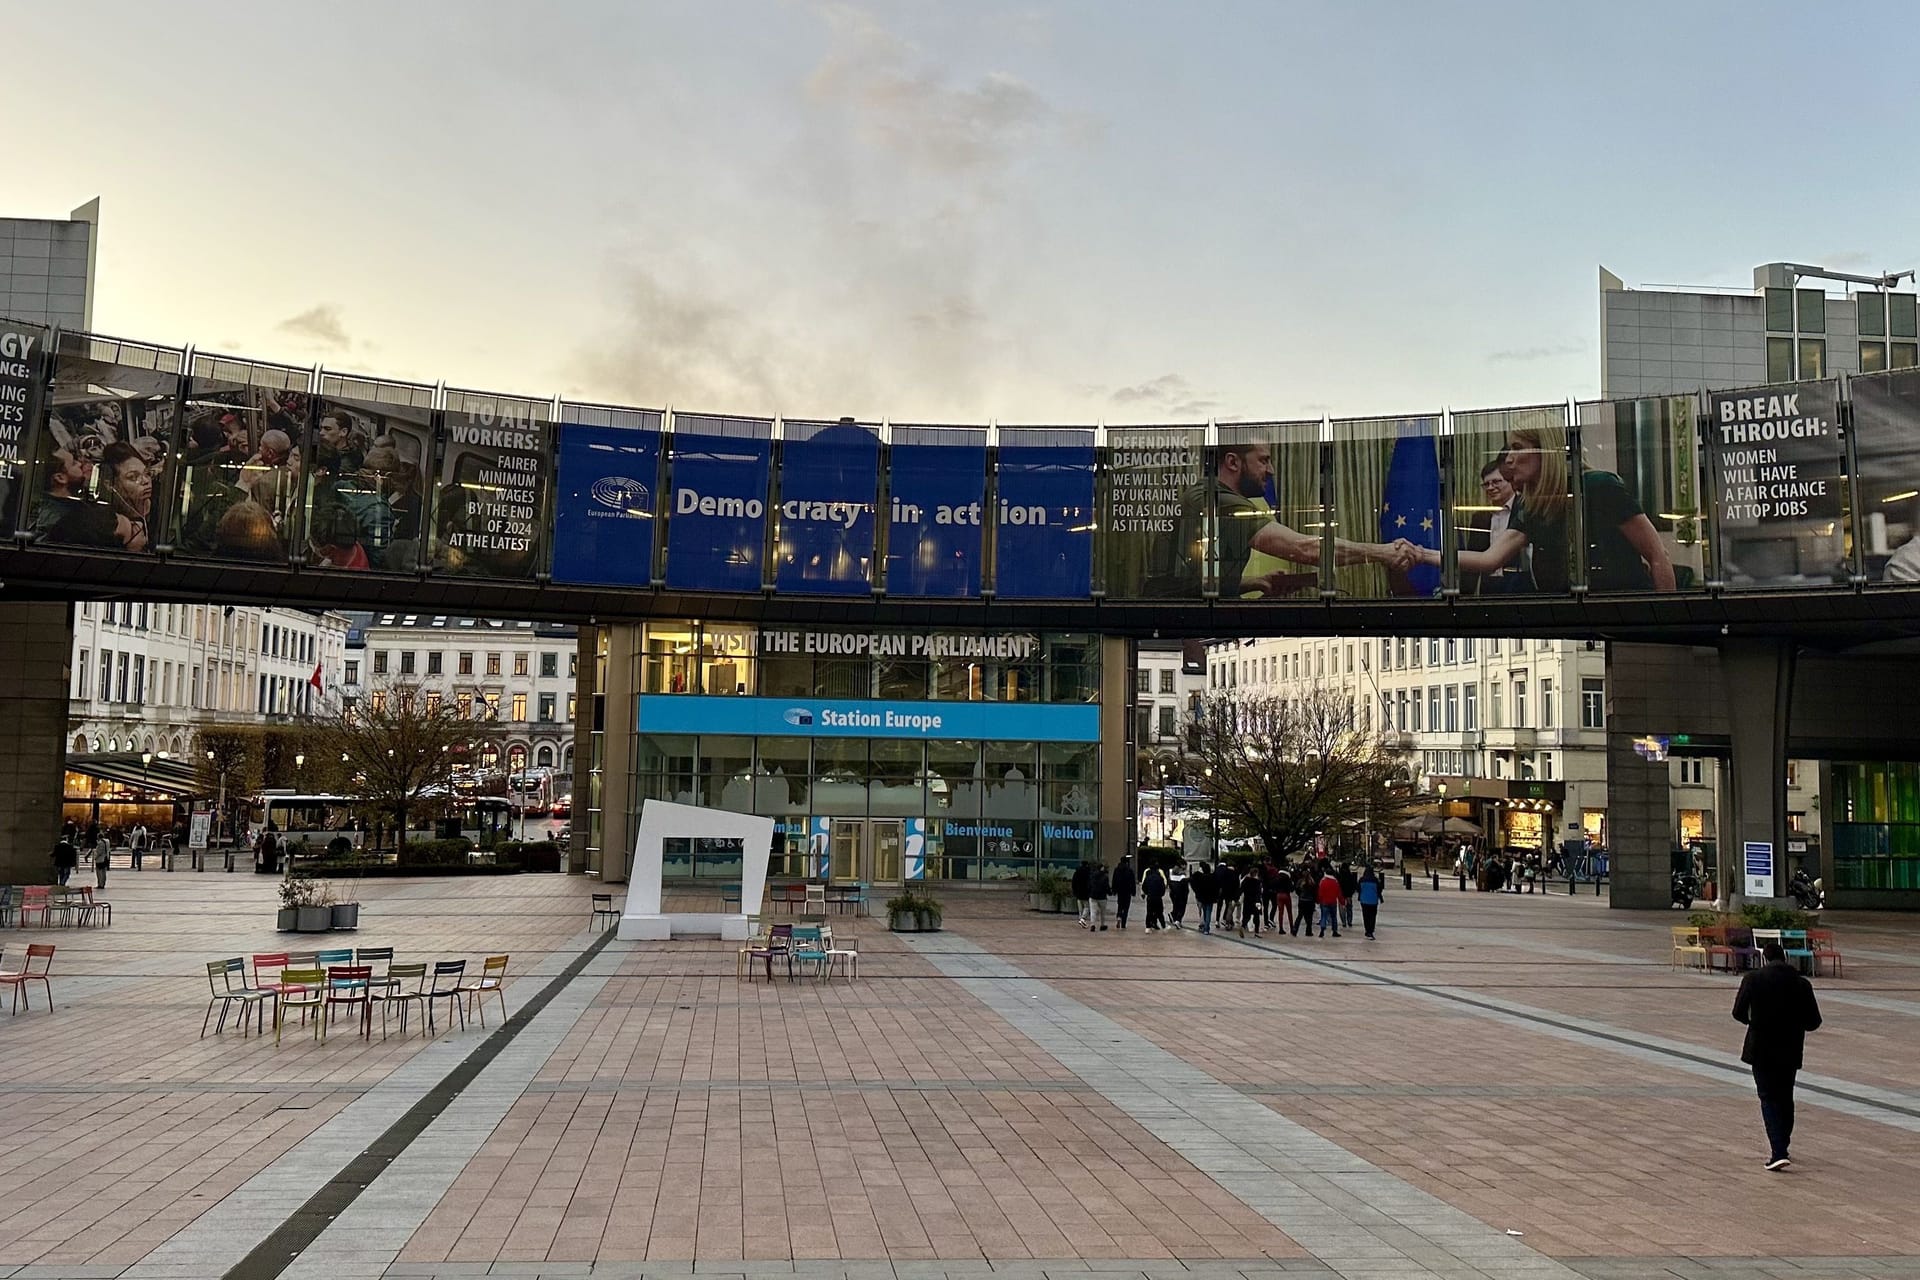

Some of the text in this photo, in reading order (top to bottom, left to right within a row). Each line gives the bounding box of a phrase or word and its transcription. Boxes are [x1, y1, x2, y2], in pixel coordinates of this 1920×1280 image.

[0, 385, 26, 402] ING
[467, 402, 540, 431] TO ALL
[1720, 394, 1799, 422] BREAK
[452, 426, 539, 450] WORKERS:
[1720, 417, 1828, 444] THROUGH:
[1113, 436, 1189, 449] DEFENDING
[498, 455, 538, 472] FAIRER
[1113, 452, 1200, 466] DEMOCRACY:
[1722, 449, 1777, 466] WOMEN
[478, 470, 536, 487] MINIMUM
[1113, 473, 1197, 486] WE WILL STAND
[1723, 465, 1797, 484] WILL HAVE
[495, 488, 534, 503] WAGES
[1113, 489, 1178, 501] BY UKRAINE
[1725, 481, 1826, 502] A FAIR CHANCE
[468, 502, 533, 519] BY THE END
[677, 488, 763, 518] Demo
[783, 500, 861, 529] cracy
[892, 496, 919, 523] in
[935, 502, 980, 525] act
[1113, 504, 1182, 516] FOR AS LONG
[1726, 500, 1808, 520] AT TOP JOBS
[487, 519, 532, 535] OF 2024
[1112, 519, 1174, 532] AS IT TAKES
[449, 533, 531, 551] AT THE LATEST
[711, 631, 1033, 658] VISIT THE EUROPEAN PARLIAMENT
[821, 709, 942, 732] Station Europe
[945, 823, 1094, 839] Bienvenue Welkom
